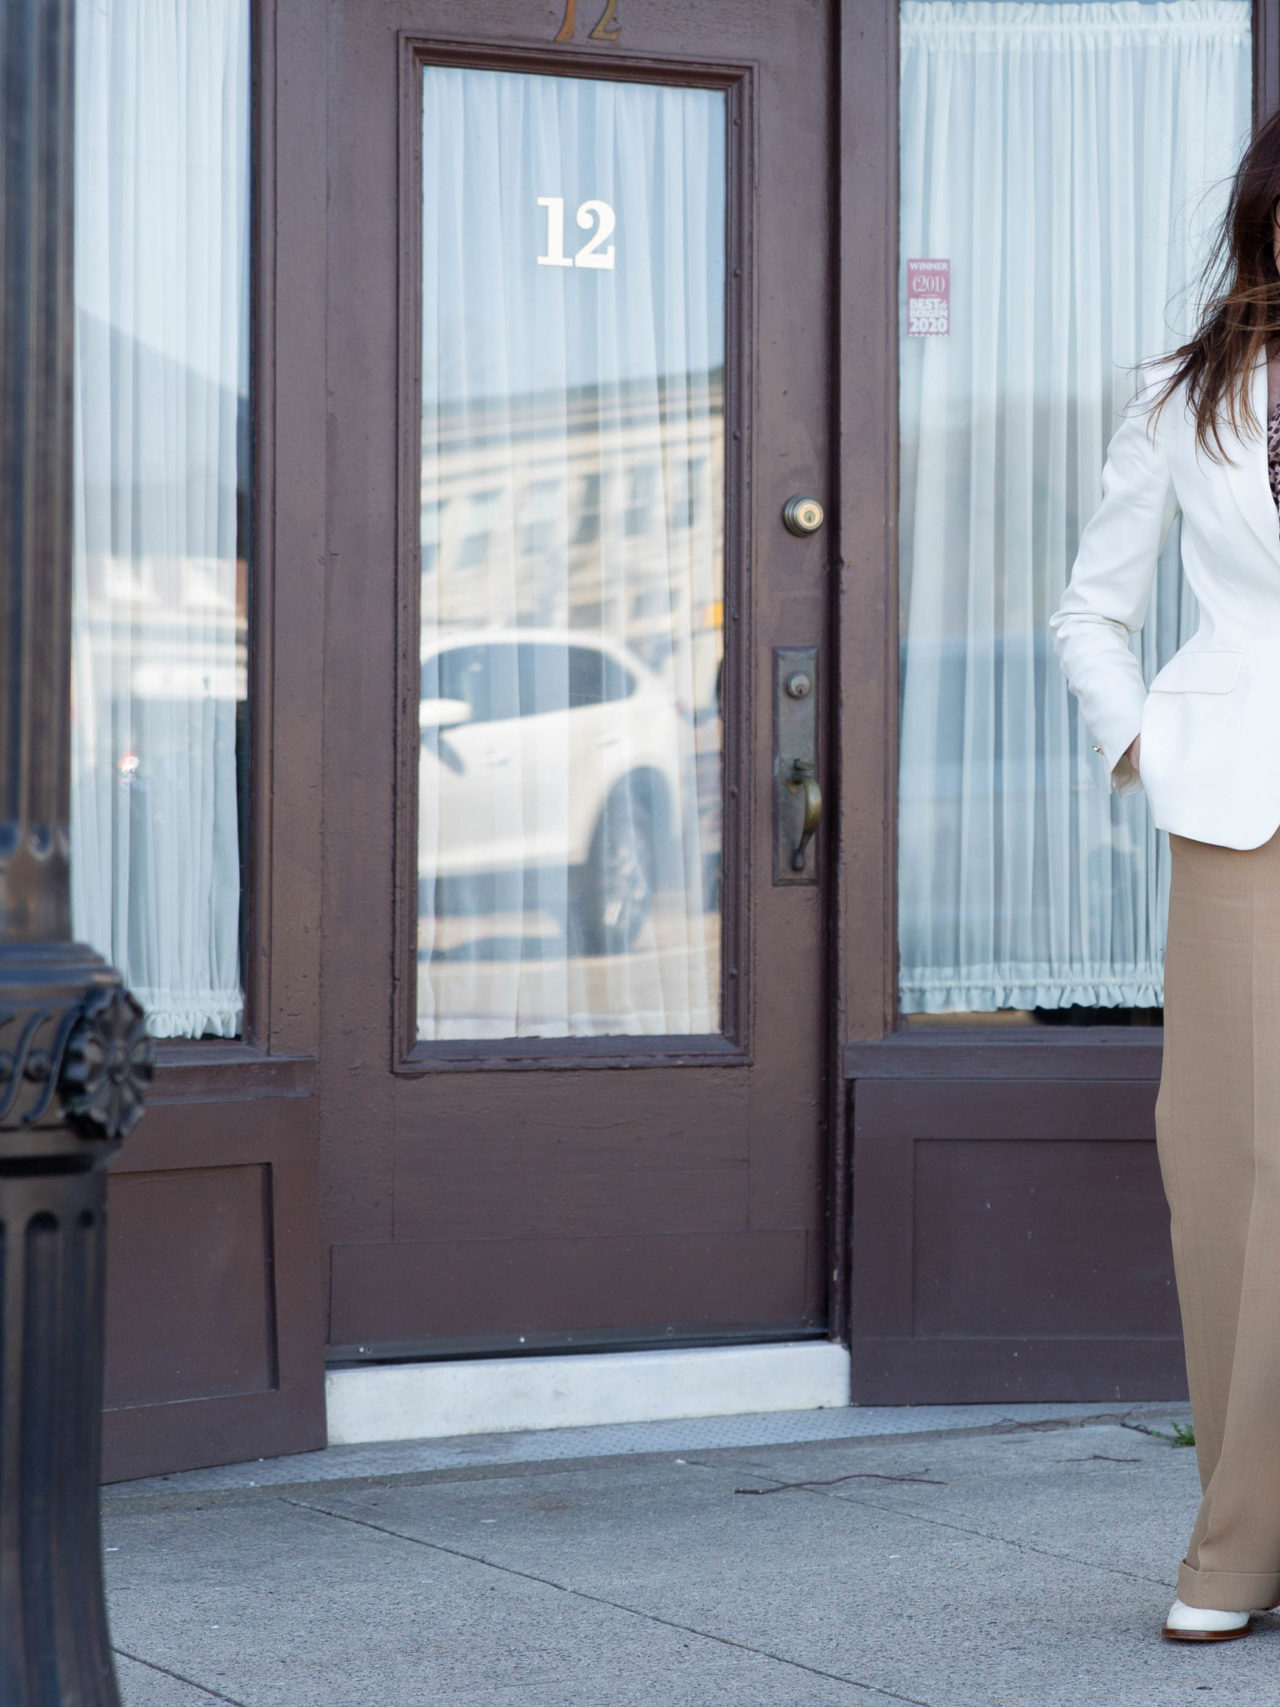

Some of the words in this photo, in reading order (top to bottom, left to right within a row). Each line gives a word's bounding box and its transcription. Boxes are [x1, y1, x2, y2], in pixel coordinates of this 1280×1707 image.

[537, 197, 616, 270] 12
[910, 262, 948, 271] WINNER
[910, 298, 940, 309] BEST
[910, 318, 948, 332] 2020
